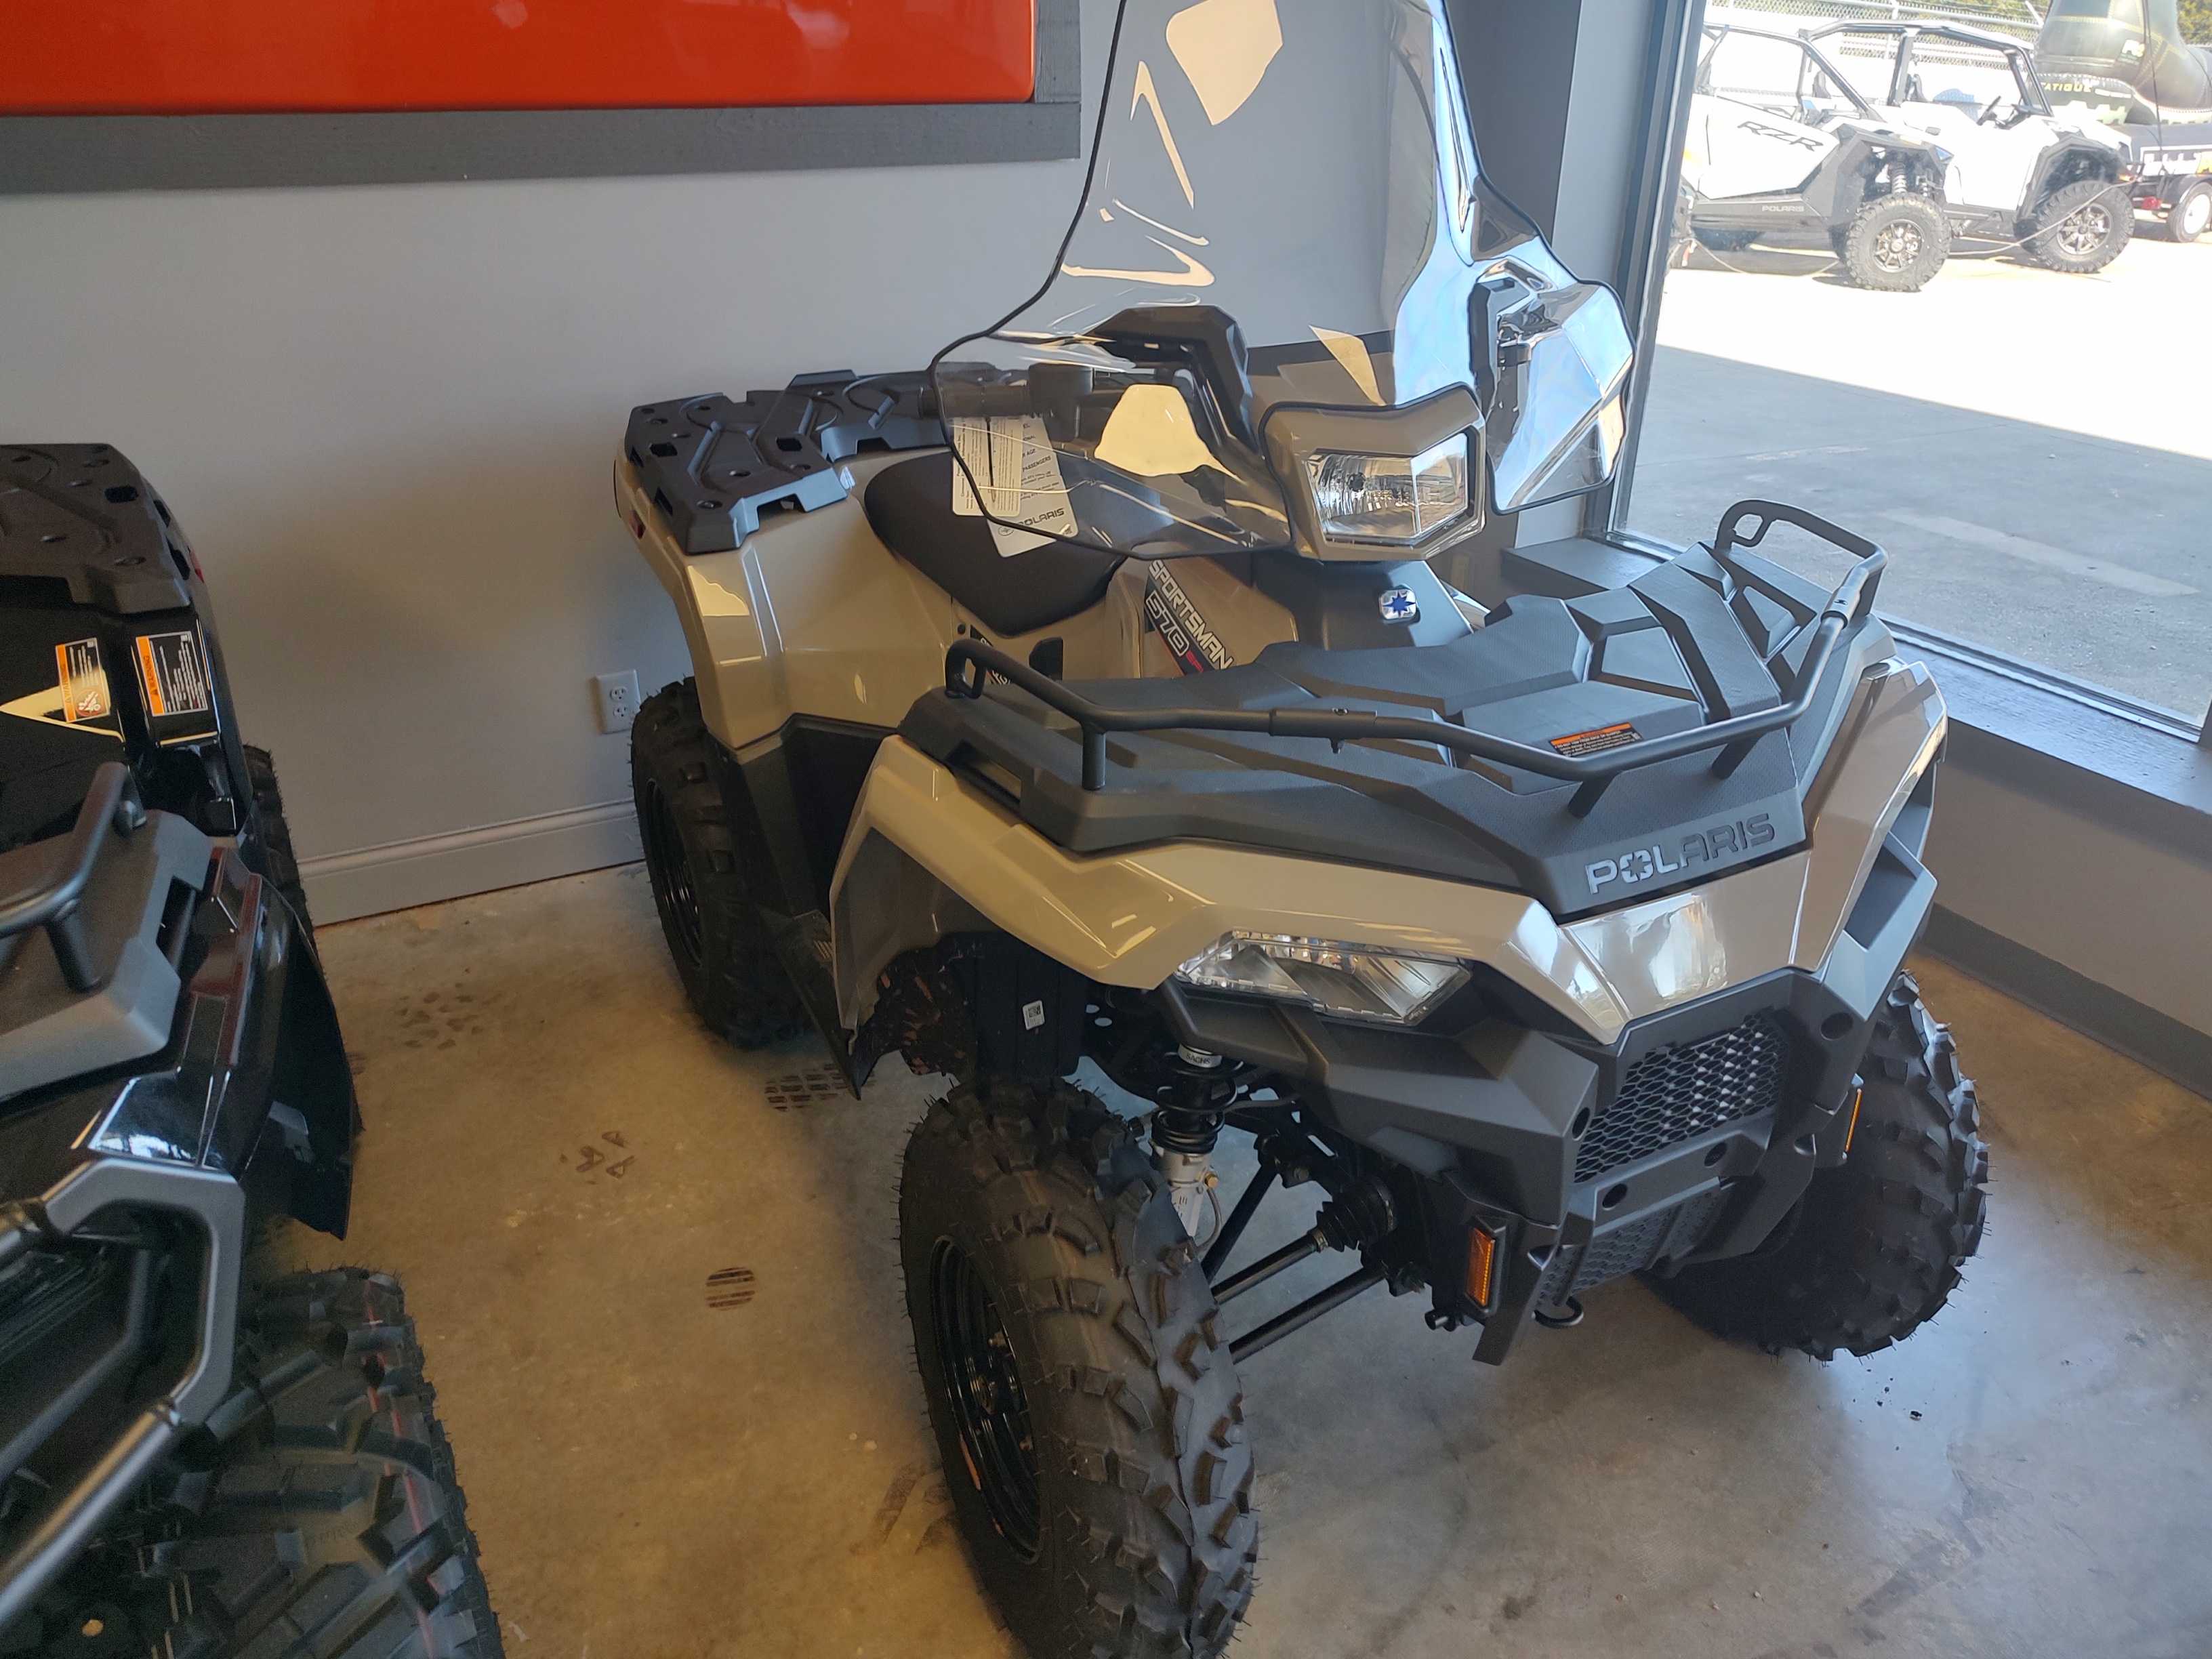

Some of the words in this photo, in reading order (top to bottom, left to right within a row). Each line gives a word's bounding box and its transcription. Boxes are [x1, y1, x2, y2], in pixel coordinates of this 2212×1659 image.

[1022, 455, 1052, 472] PASSENGERS
[1146, 590, 1190, 657] 570
[1149, 559, 1234, 670] SPORTSMAN
[1585, 813, 1775, 895] POLARIS
[1187, 1053, 1210, 1065] SACHS
